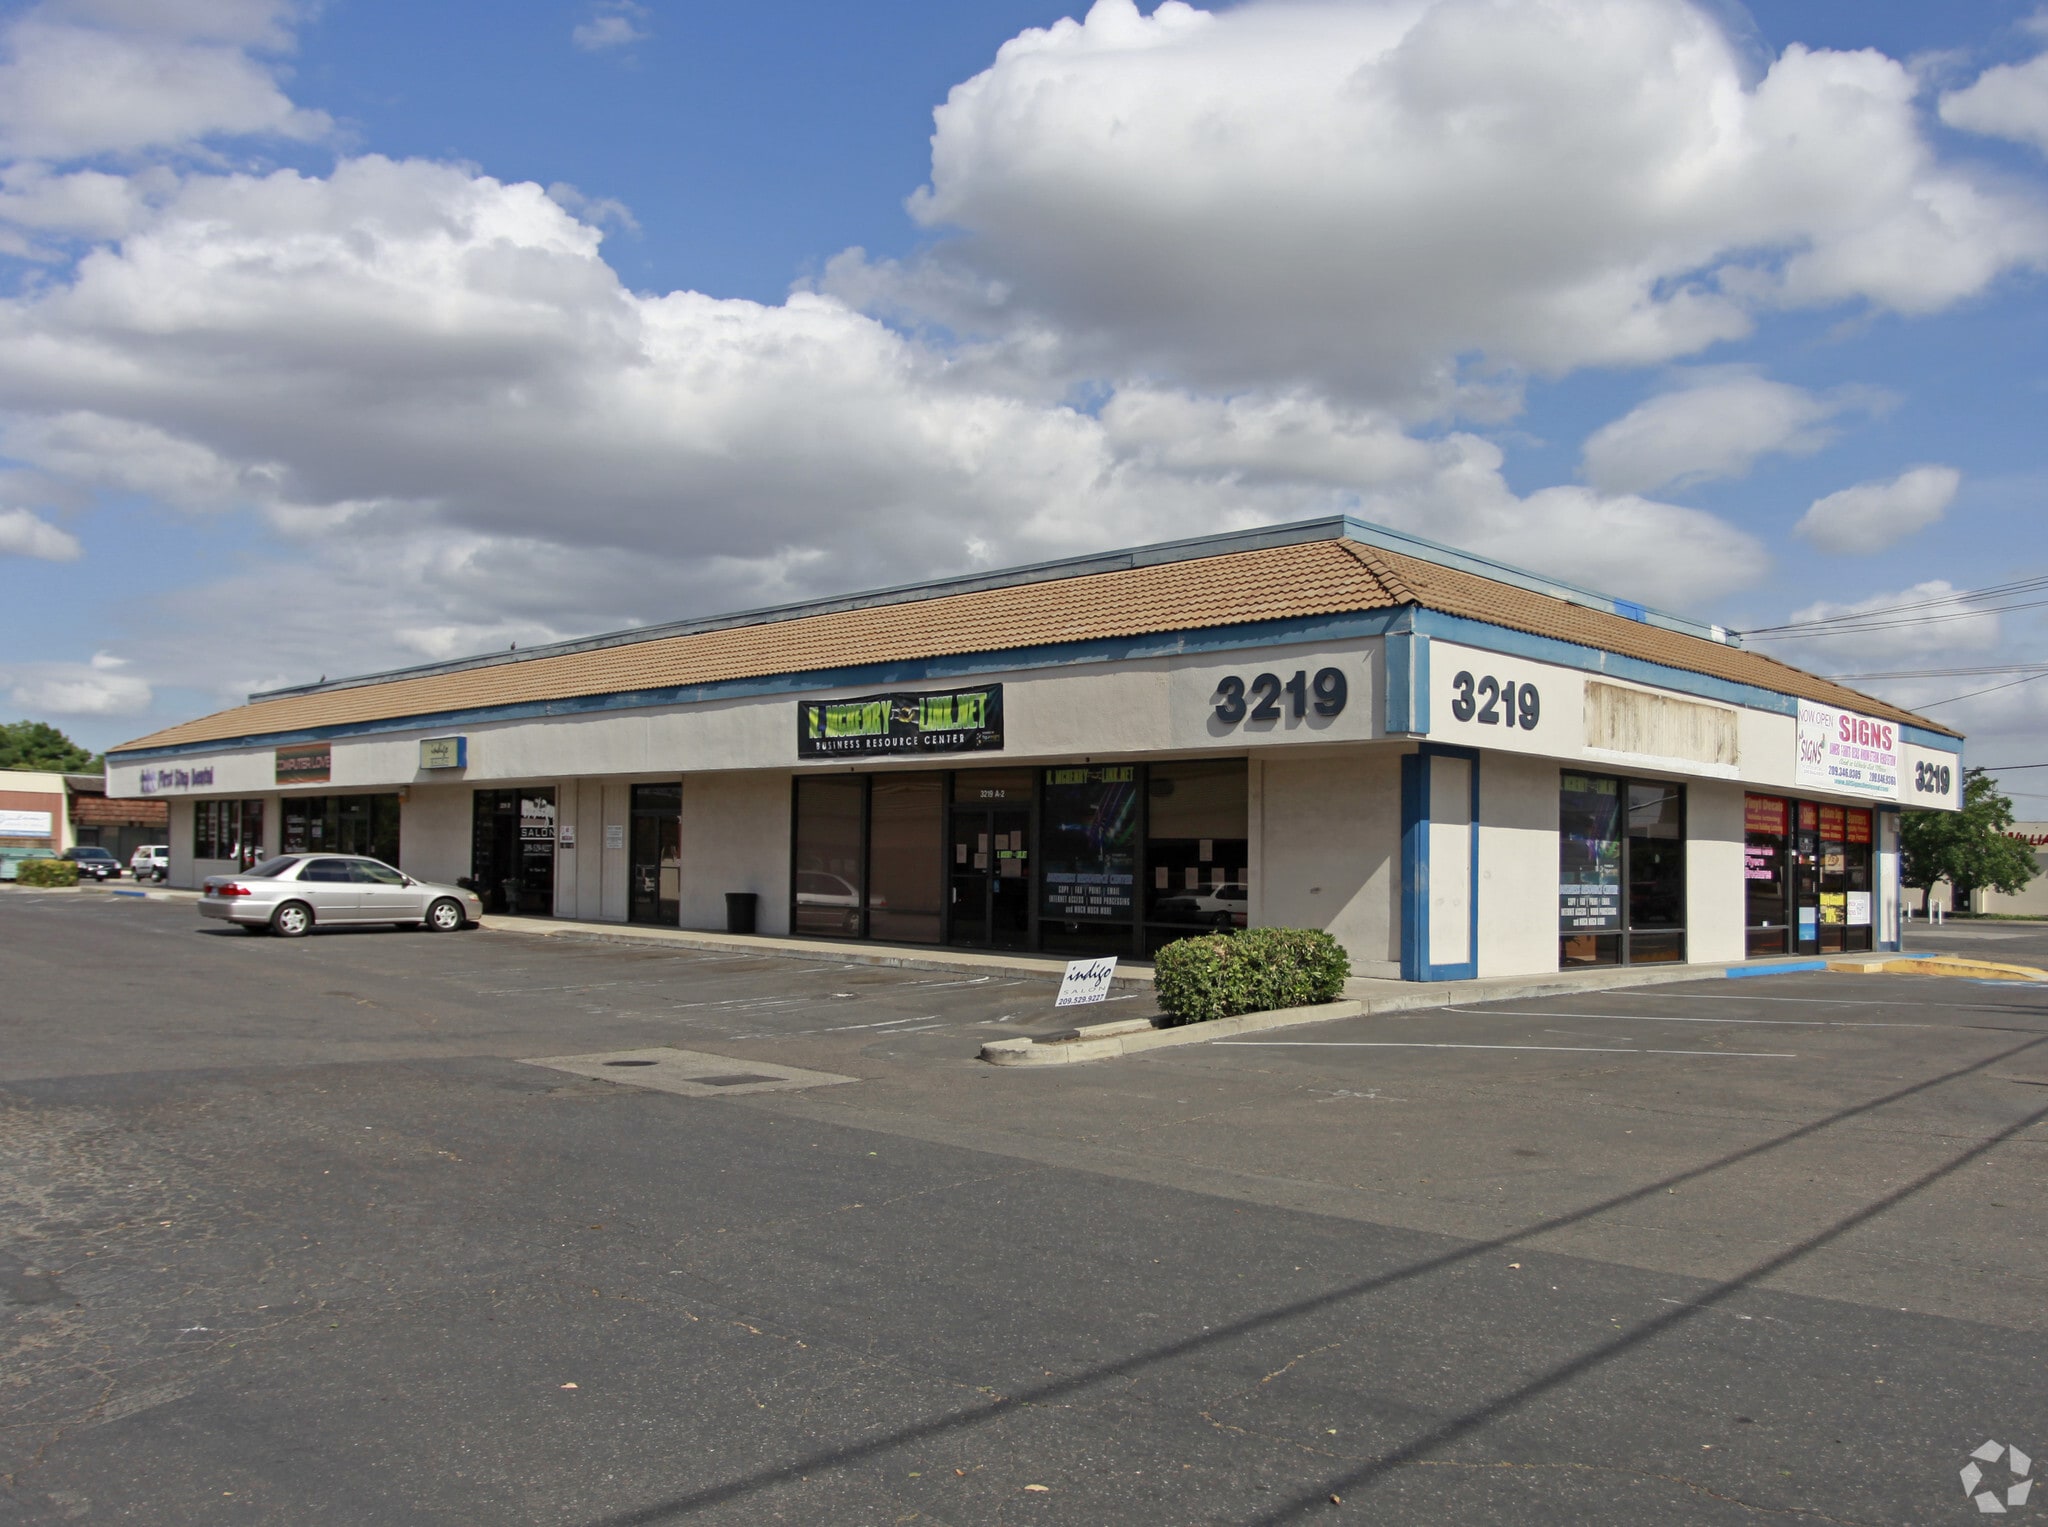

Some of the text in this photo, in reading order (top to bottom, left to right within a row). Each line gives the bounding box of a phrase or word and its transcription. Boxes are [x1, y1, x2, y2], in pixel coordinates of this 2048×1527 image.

[1216, 667, 1347, 723] 3219
[1452, 671, 1540, 731] 3219
[825, 700, 892, 737] MCHENRY
[919, 693, 987, 732] LINK.NET
[1799, 708, 1834, 728] NOW OPEN
[815, 733, 965, 751] BUSINESS RESOURCE CENTER
[1839, 714, 1893, 752] SIGNS
[1800, 739, 1823, 764] SIGNS
[1915, 760, 1951, 795] 3219
[980, 790, 1005, 798] 3219 A-2
[521, 828, 555, 837] SALON
[1067, 961, 1112, 988] indigo
[1063, 986, 1106, 996] SALON
